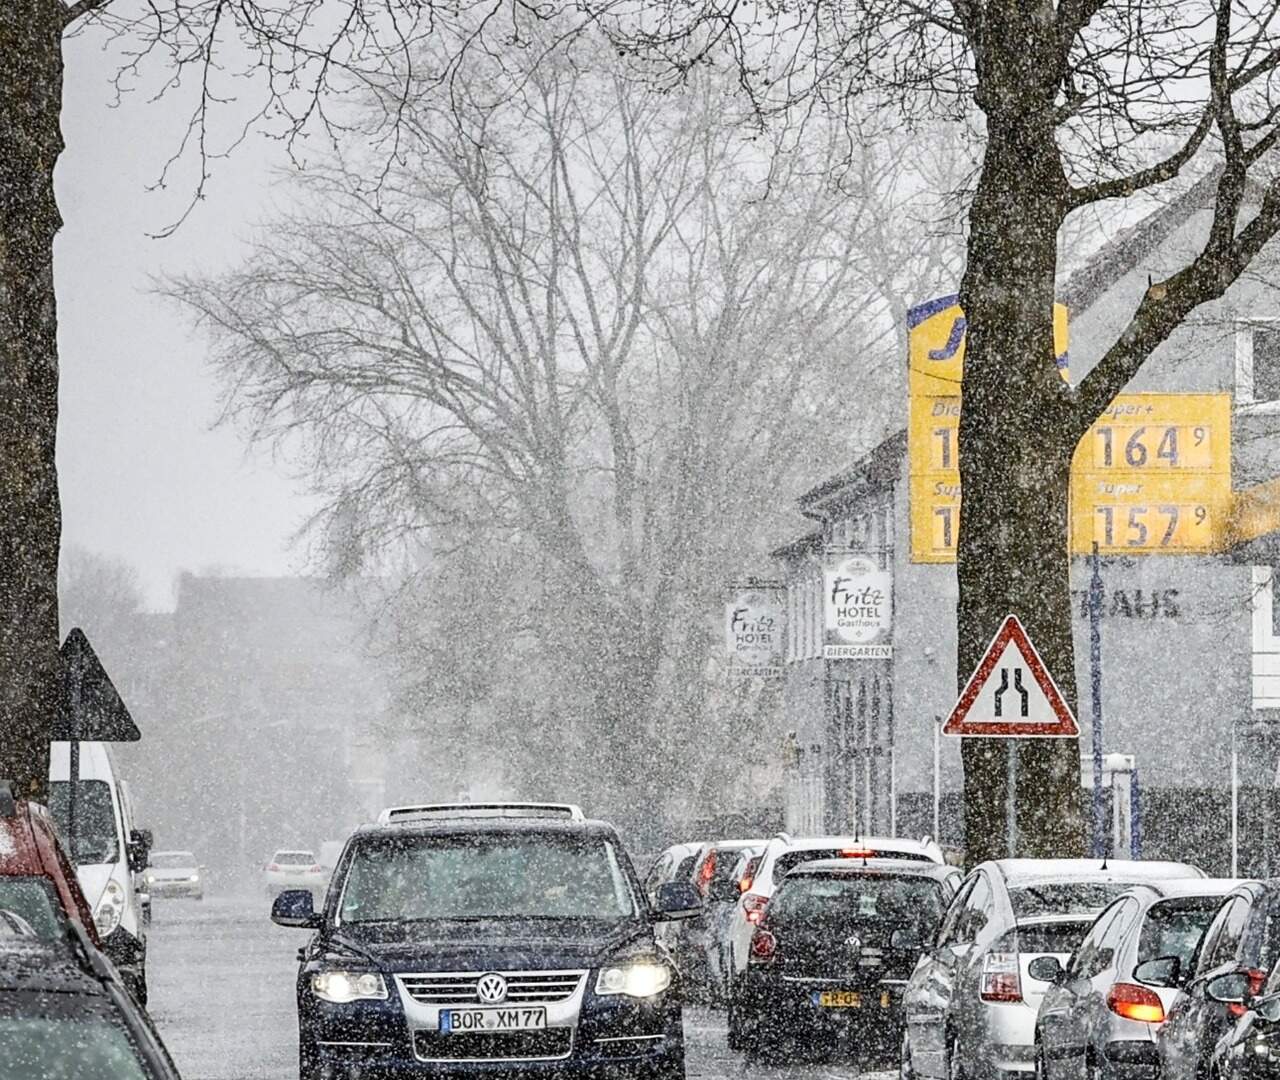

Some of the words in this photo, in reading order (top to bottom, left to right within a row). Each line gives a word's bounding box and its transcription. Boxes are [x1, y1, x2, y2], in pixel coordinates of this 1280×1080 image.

[1103, 404, 1154, 419] uper+
[831, 576, 885, 605] Fritz
[836, 606, 881, 618] HOTEL
[451, 1012, 484, 1029] BOR
